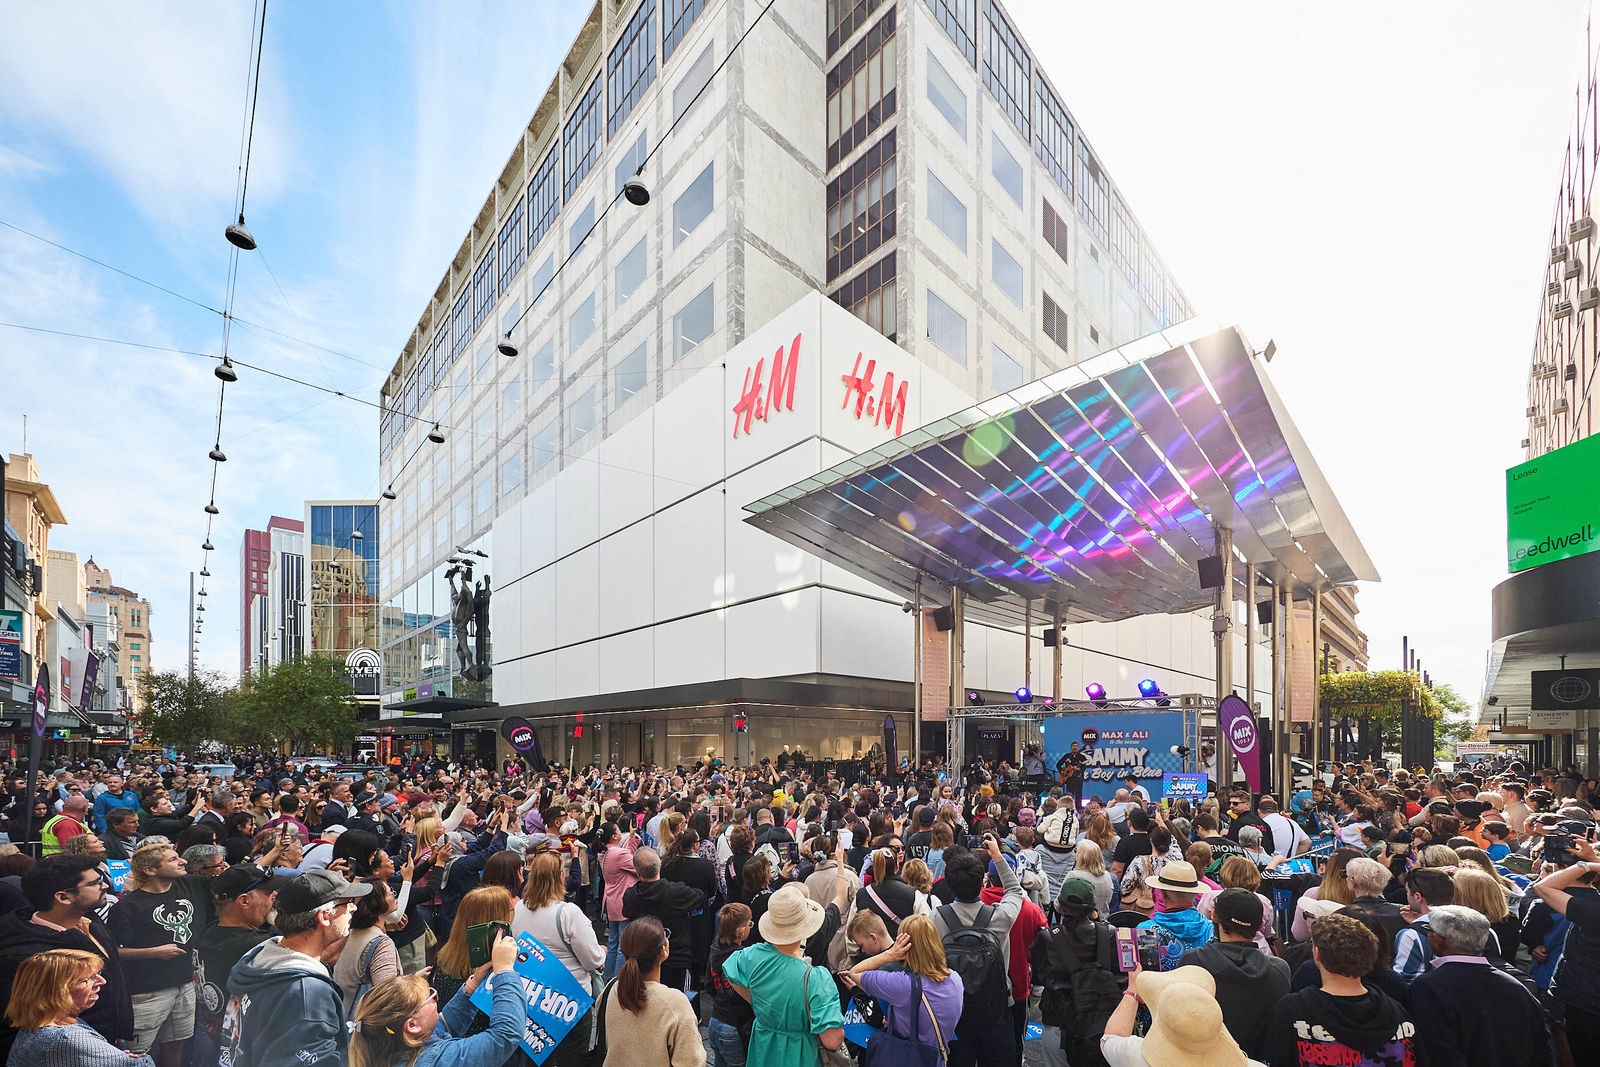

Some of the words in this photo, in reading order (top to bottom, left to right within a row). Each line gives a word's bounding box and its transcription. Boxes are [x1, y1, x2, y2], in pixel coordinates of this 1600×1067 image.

[733, 332, 802, 439] H&M
[842, 351, 909, 437] H&M
[1512, 467, 1538, 481] Lease
[514, 732, 532, 743] MIX
[1101, 731, 1123, 739] MAX
[1132, 731, 1149, 739] ALI
[1233, 726, 1252, 741] MIX
[1080, 747, 1149, 766] SAMMY
[1091, 767, 1115, 781] Boy
[1117, 767, 1130, 779] in
[1132, 765, 1163, 778] Blue
[540, 987, 579, 1023] OUR
